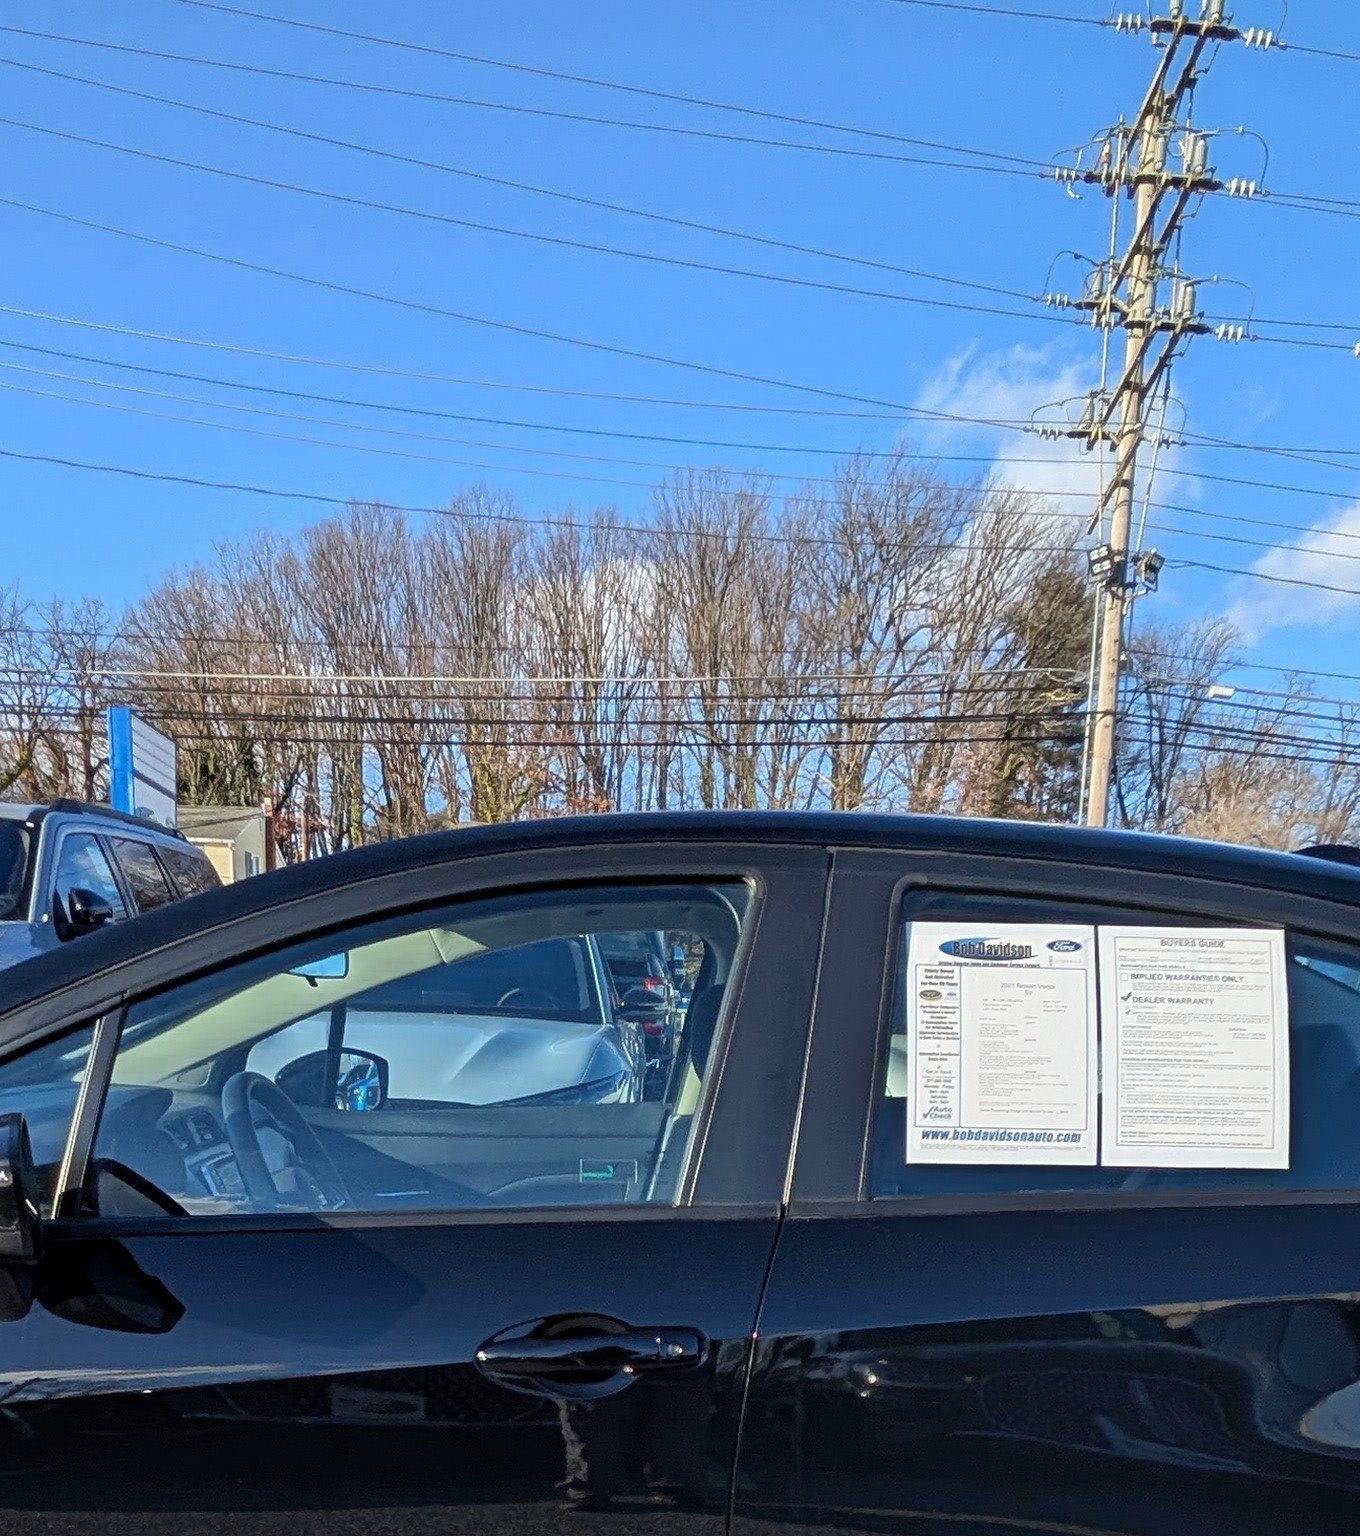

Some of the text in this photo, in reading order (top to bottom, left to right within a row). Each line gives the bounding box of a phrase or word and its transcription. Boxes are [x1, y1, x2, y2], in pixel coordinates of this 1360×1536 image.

[953, 940, 1032, 957] Bob Davidson
[1051, 940, 1078, 952] Ford
[1160, 938, 1226, 949] BUYERS GUIDE
[1130, 973, 1244, 983] IMPLIED WARRANTIES ONLY
[1132, 996, 1215, 1005] DEALER WARRANTY
[921, 1129, 1082, 1143] www.bobdavidsonauto.com
